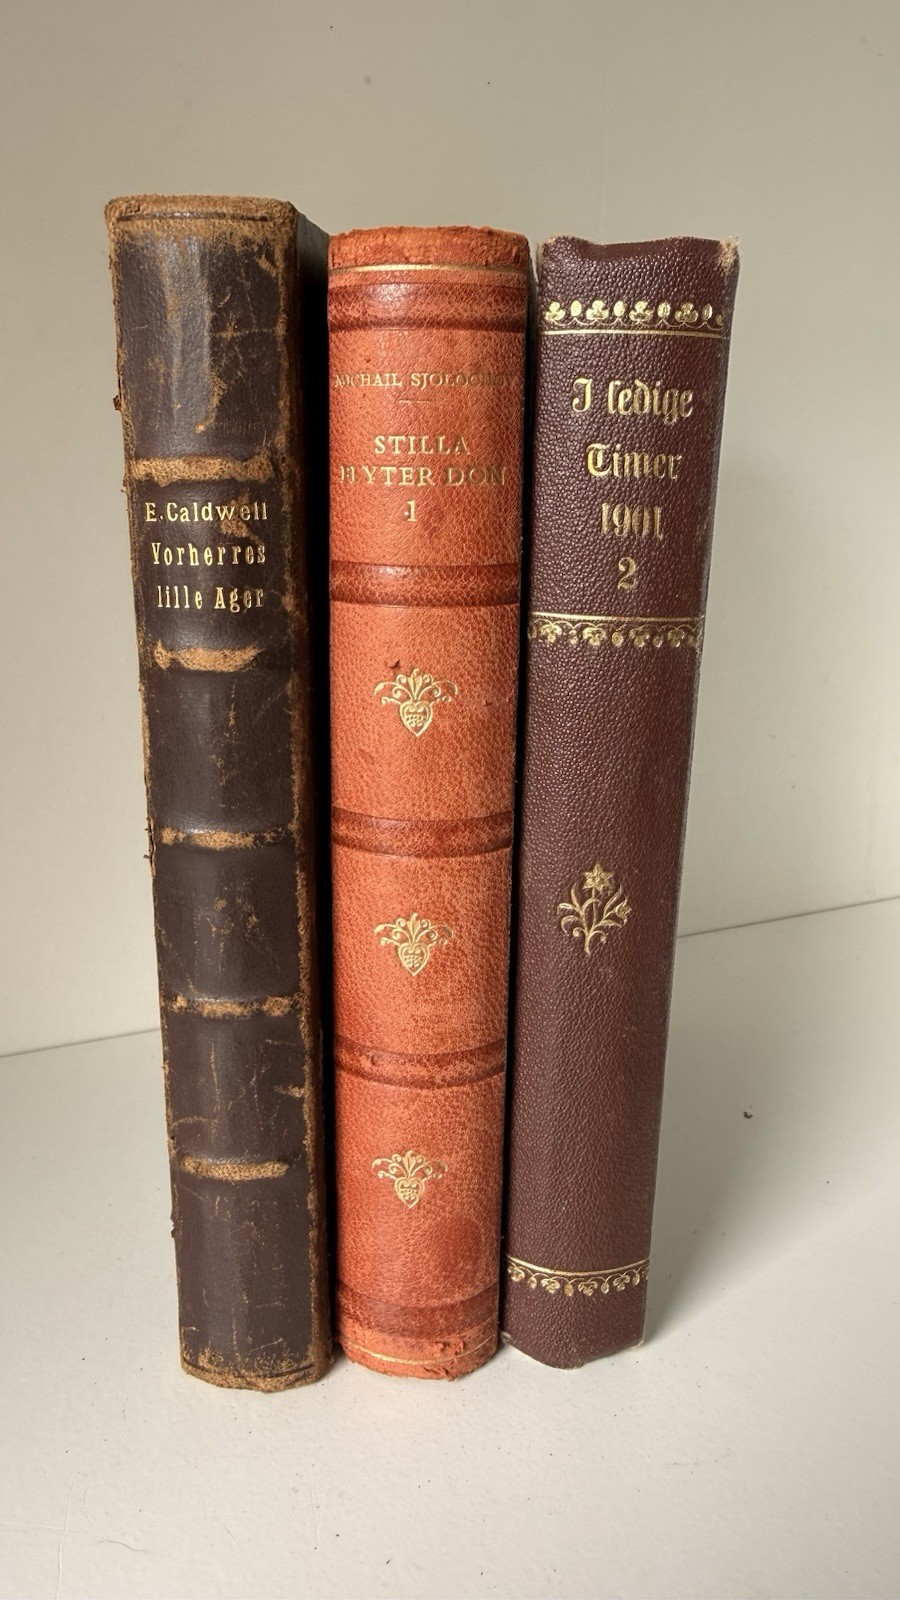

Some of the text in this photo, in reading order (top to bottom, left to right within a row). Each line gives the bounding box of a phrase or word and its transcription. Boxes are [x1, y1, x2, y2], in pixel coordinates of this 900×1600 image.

[334, 372, 402, 388] MICHAIL
[607, 378, 693, 425] ledige
[374, 435, 471, 455] STILLA
[585, 443, 682, 479] Timer
[445, 465, 507, 487] DON
[601, 502, 663, 540] 1901
[151, 542, 266, 566] Vorherres
[617, 556, 637, 589] 2
[157, 585, 264, 613] lille Ager
